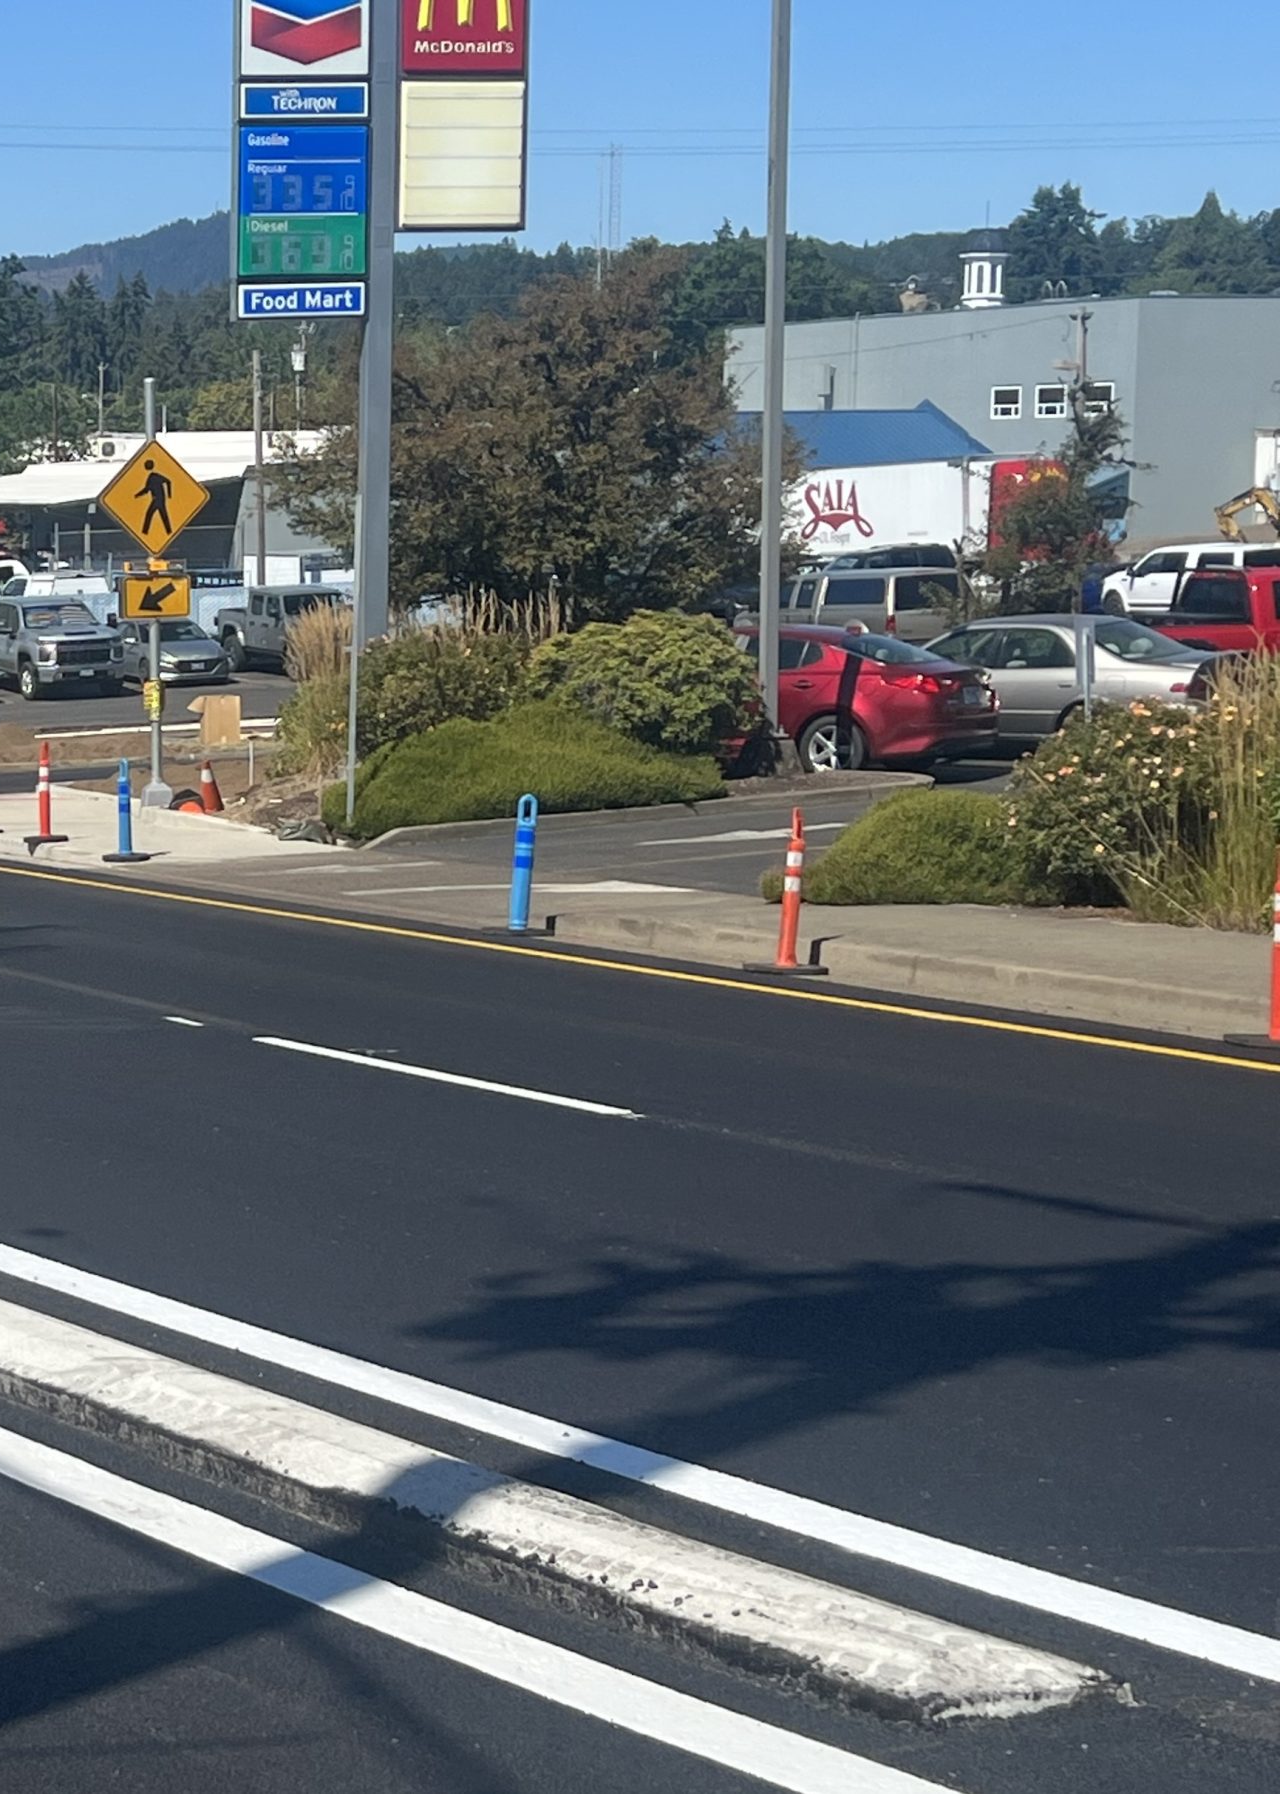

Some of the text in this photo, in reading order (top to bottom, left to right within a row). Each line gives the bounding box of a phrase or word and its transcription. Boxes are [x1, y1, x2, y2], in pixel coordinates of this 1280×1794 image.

[414, 40, 514, 54] McDonald's
[279, 89, 300, 99] with
[271, 96, 337, 113] TECHRON
[247, 133, 290, 147] Gasoline
[247, 163, 287, 176] Regular
[251, 220, 288, 233] Diesel
[251, 289, 353, 310] Food Mart
[801, 479, 873, 539] SAIA
